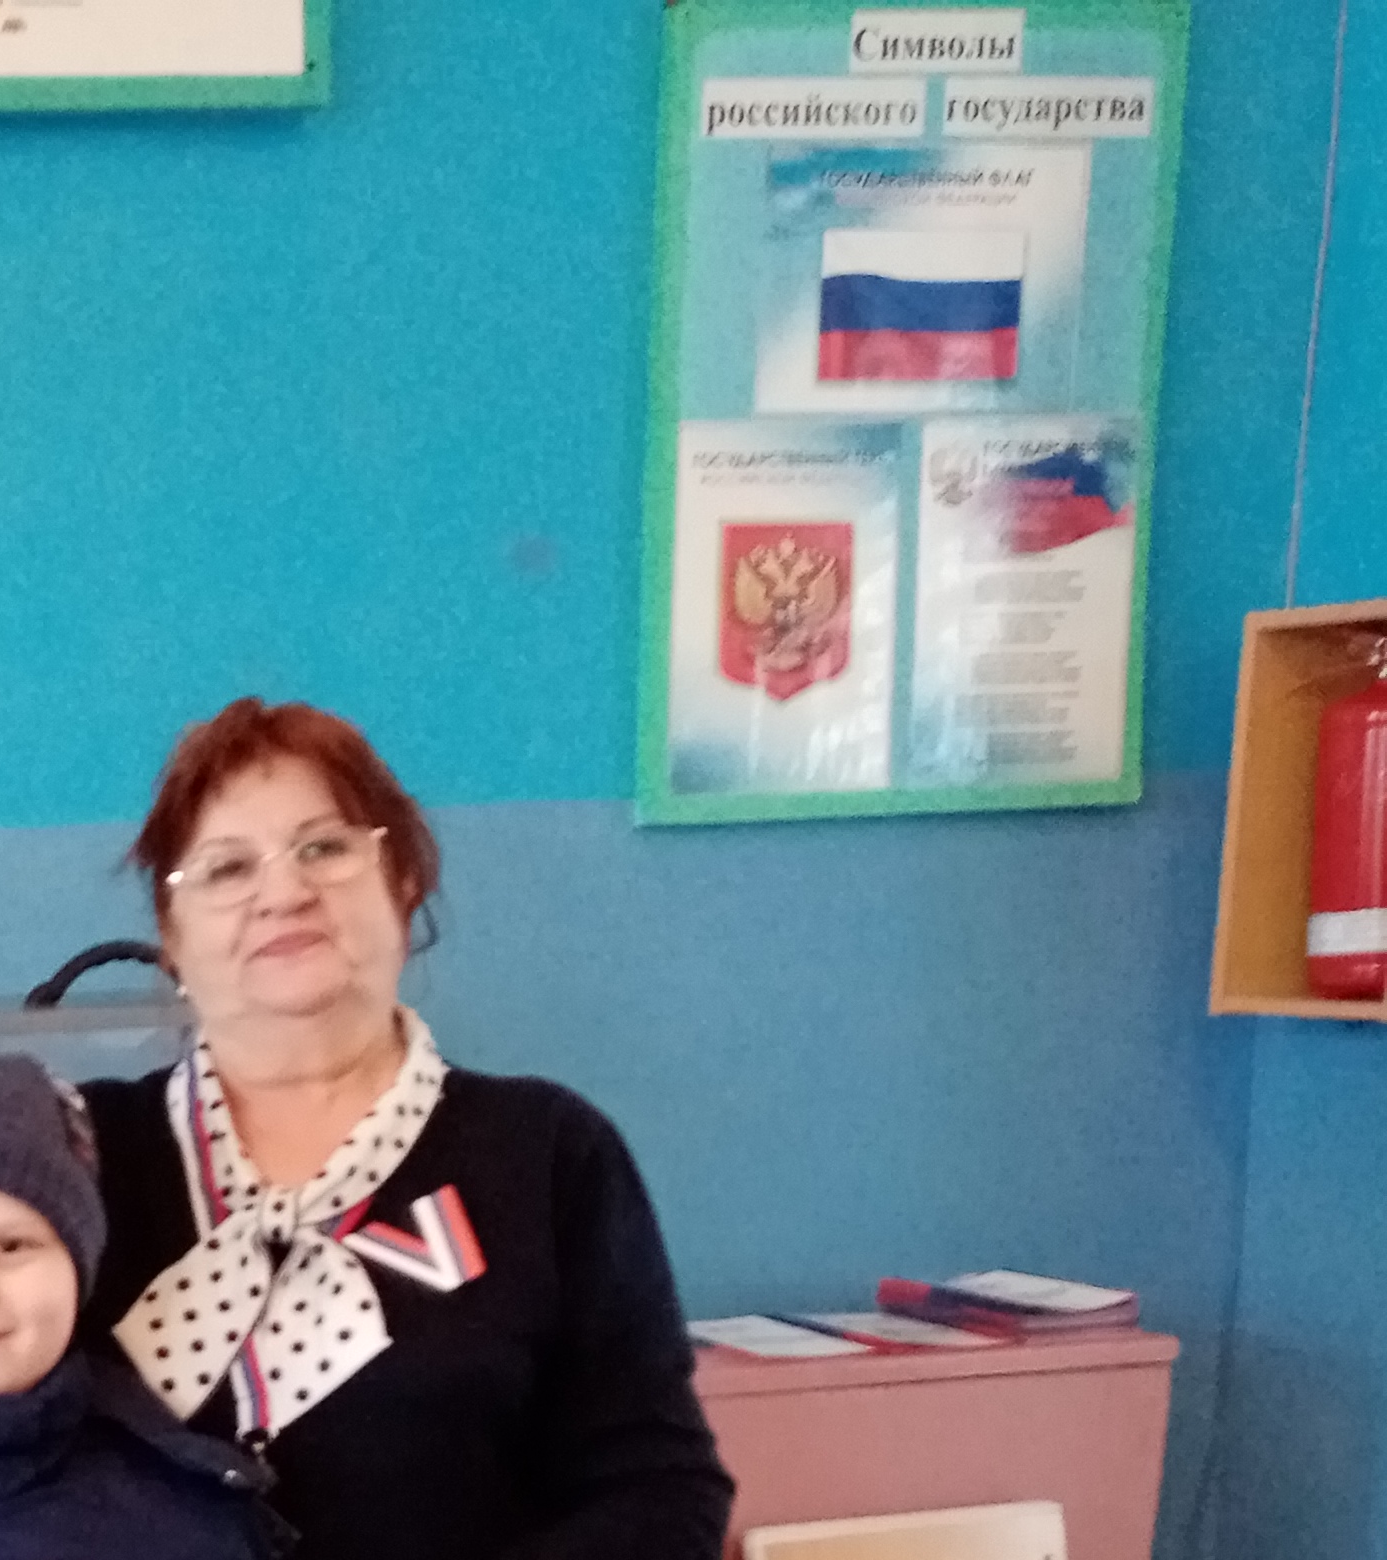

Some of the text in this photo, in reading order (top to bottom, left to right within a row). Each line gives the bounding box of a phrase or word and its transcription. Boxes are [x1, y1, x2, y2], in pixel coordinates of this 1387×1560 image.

[851, 26, 1017, 63] Символы
[704, 88, 1146, 136] российского государства
